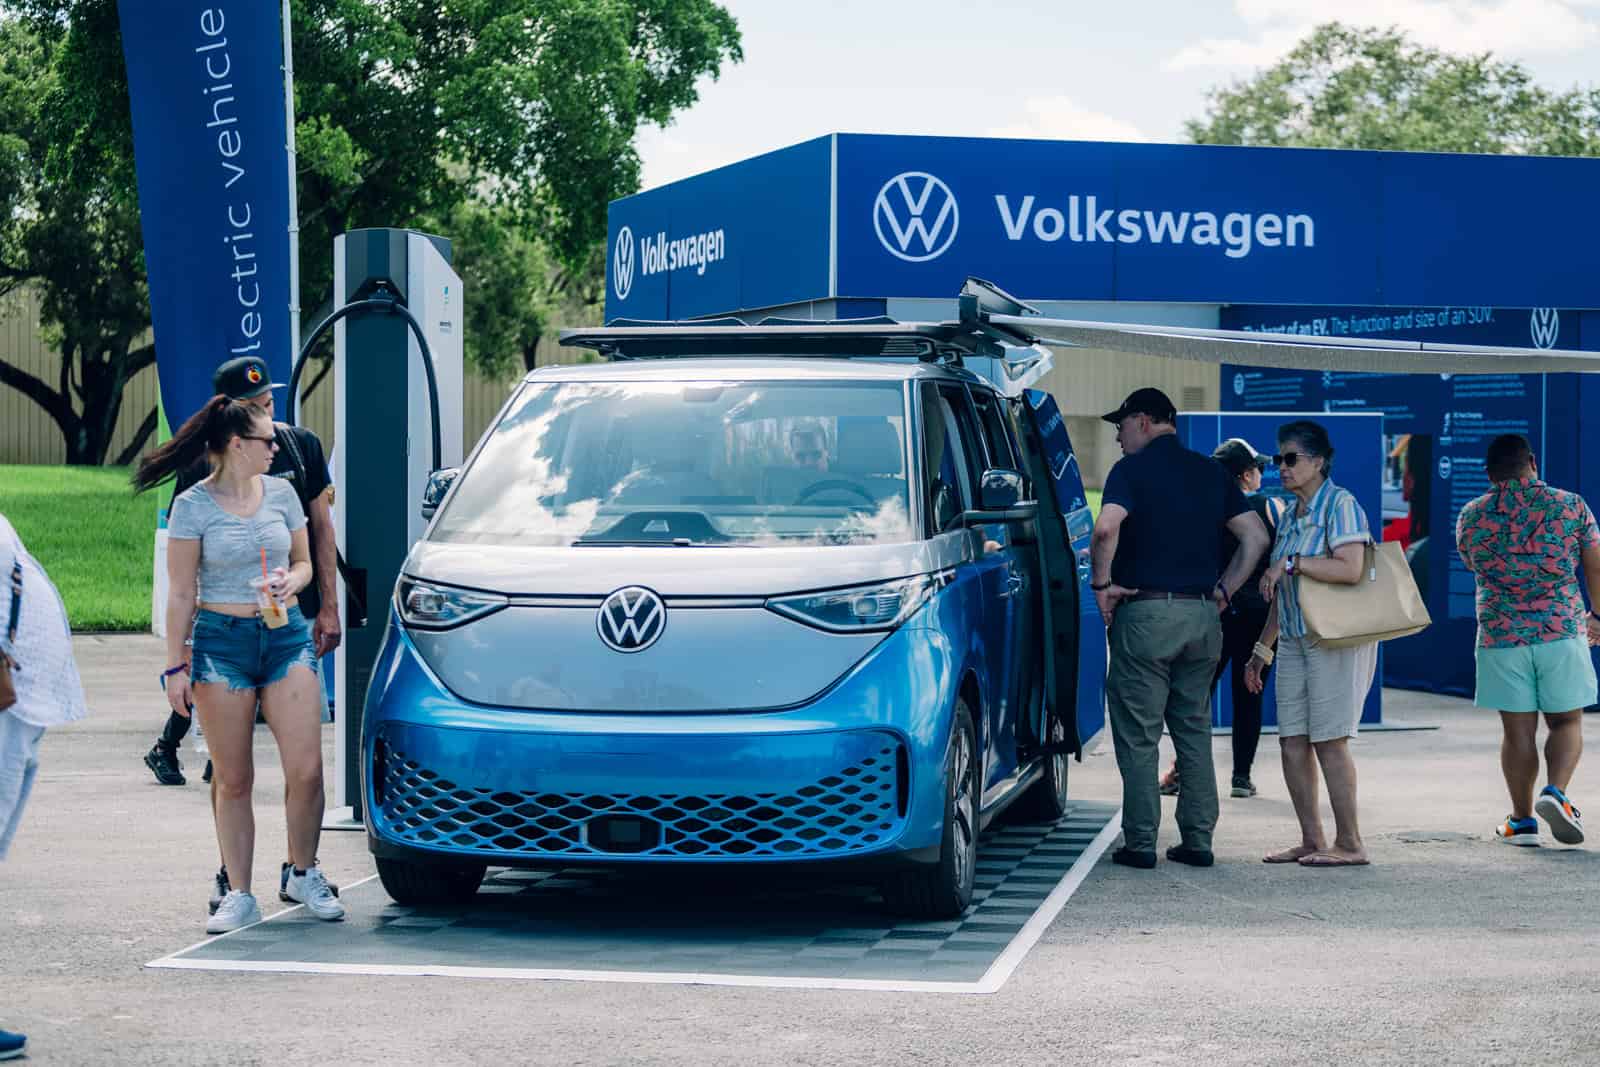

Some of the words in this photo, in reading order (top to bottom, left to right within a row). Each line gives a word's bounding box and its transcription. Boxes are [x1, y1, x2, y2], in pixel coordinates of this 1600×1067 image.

[194, 8, 246, 189] vehicle
[640, 229, 725, 276] Volkswagen
[994, 194, 1315, 259] Volkswagen
[222, 202, 262, 354] lectric
[1312, 318, 1330, 336] EV.
[1330, 316, 1349, 336] The
[1351, 314, 1392, 333] function
[1393, 310, 1413, 330] and
[1415, 311, 1435, 328] size
[1437, 306, 1449, 326] of
[1451, 310, 1466, 325] an
[1468, 306, 1496, 324] SUV.
